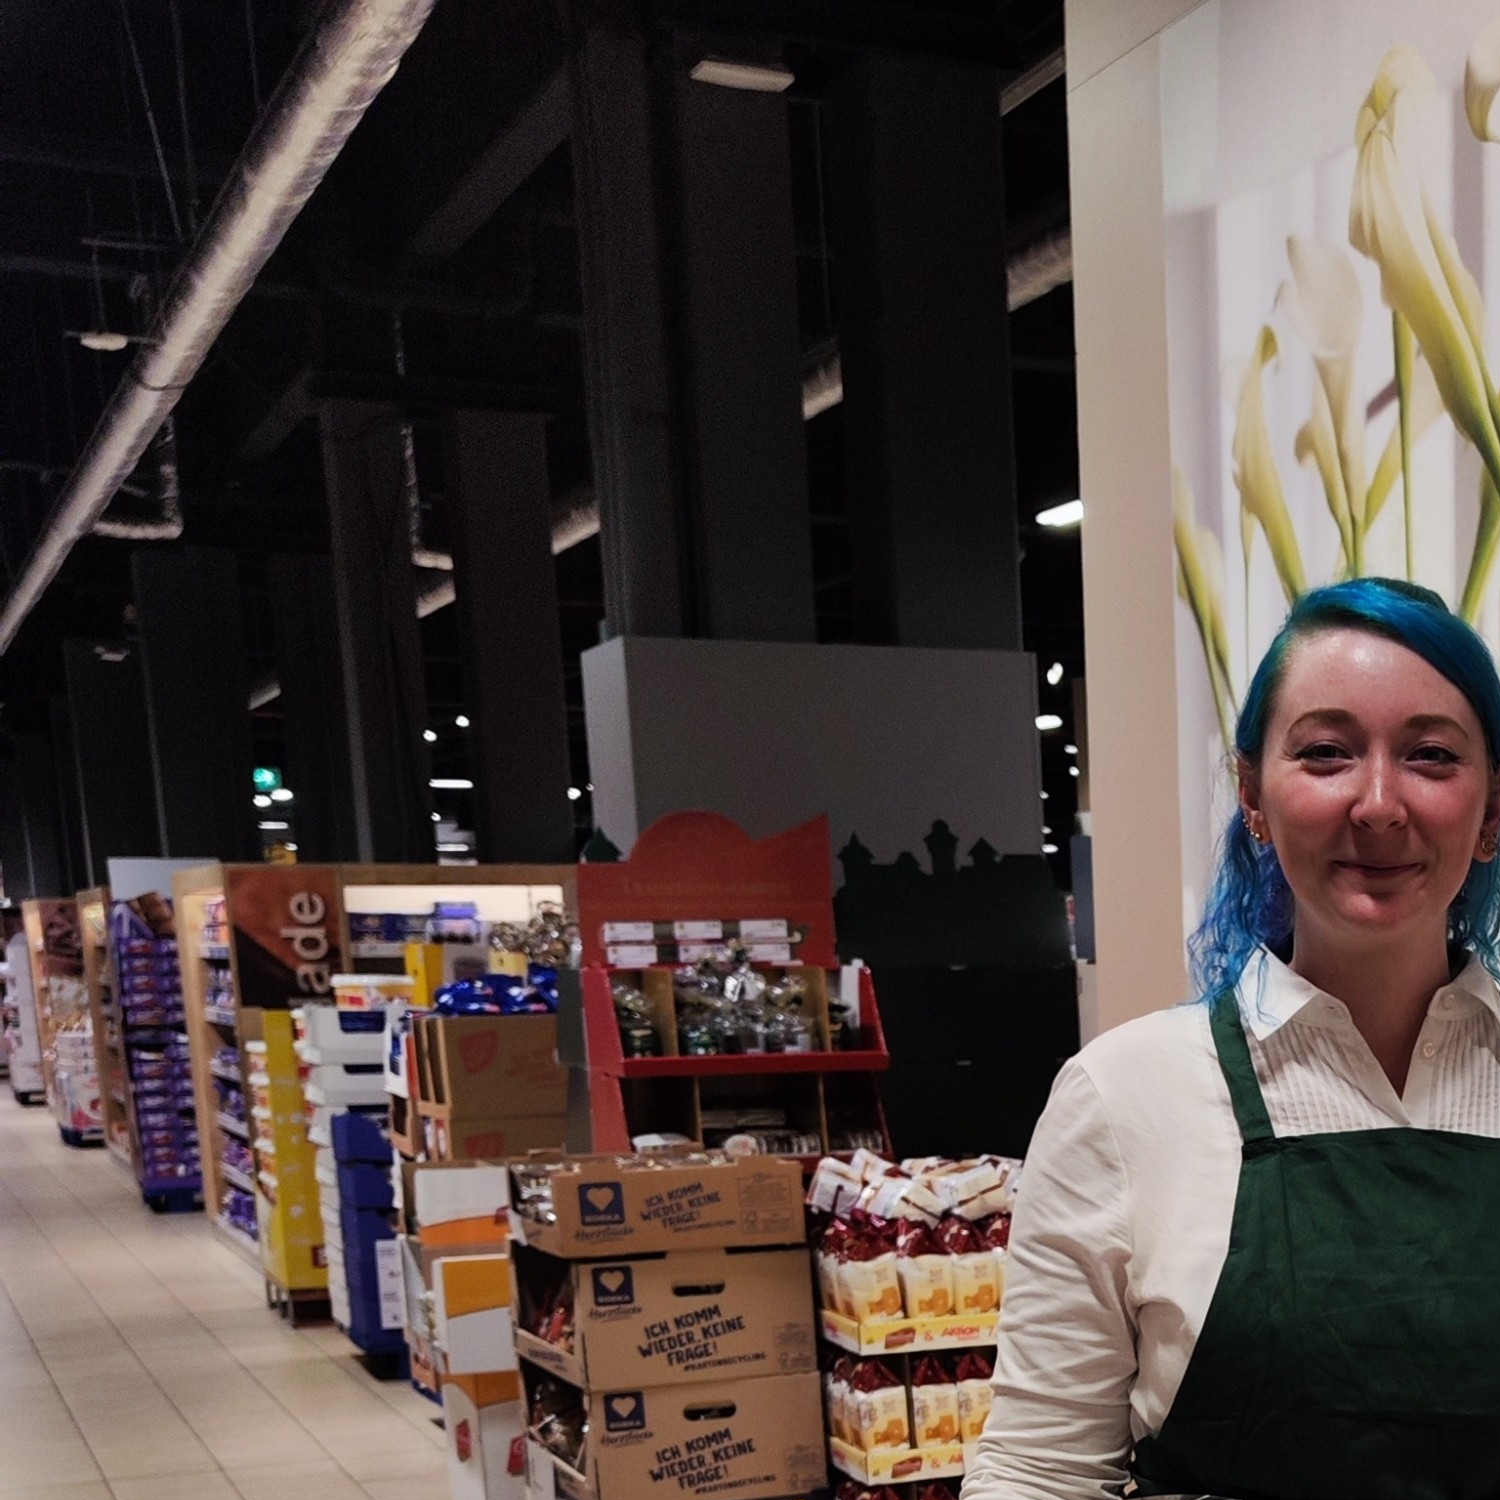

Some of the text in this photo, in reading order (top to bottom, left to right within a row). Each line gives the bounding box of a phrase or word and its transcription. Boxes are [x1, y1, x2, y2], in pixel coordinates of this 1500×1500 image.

[644, 1304, 722, 1341] ICH KOMM
[702, 1315, 747, 1340] KEINE
[666, 1341, 718, 1367] FRAGE!
[655, 1427, 733, 1465] ICH KOMM
[713, 1438, 757, 1464] KEINE
[677, 1464, 730, 1490] FRAGE!
